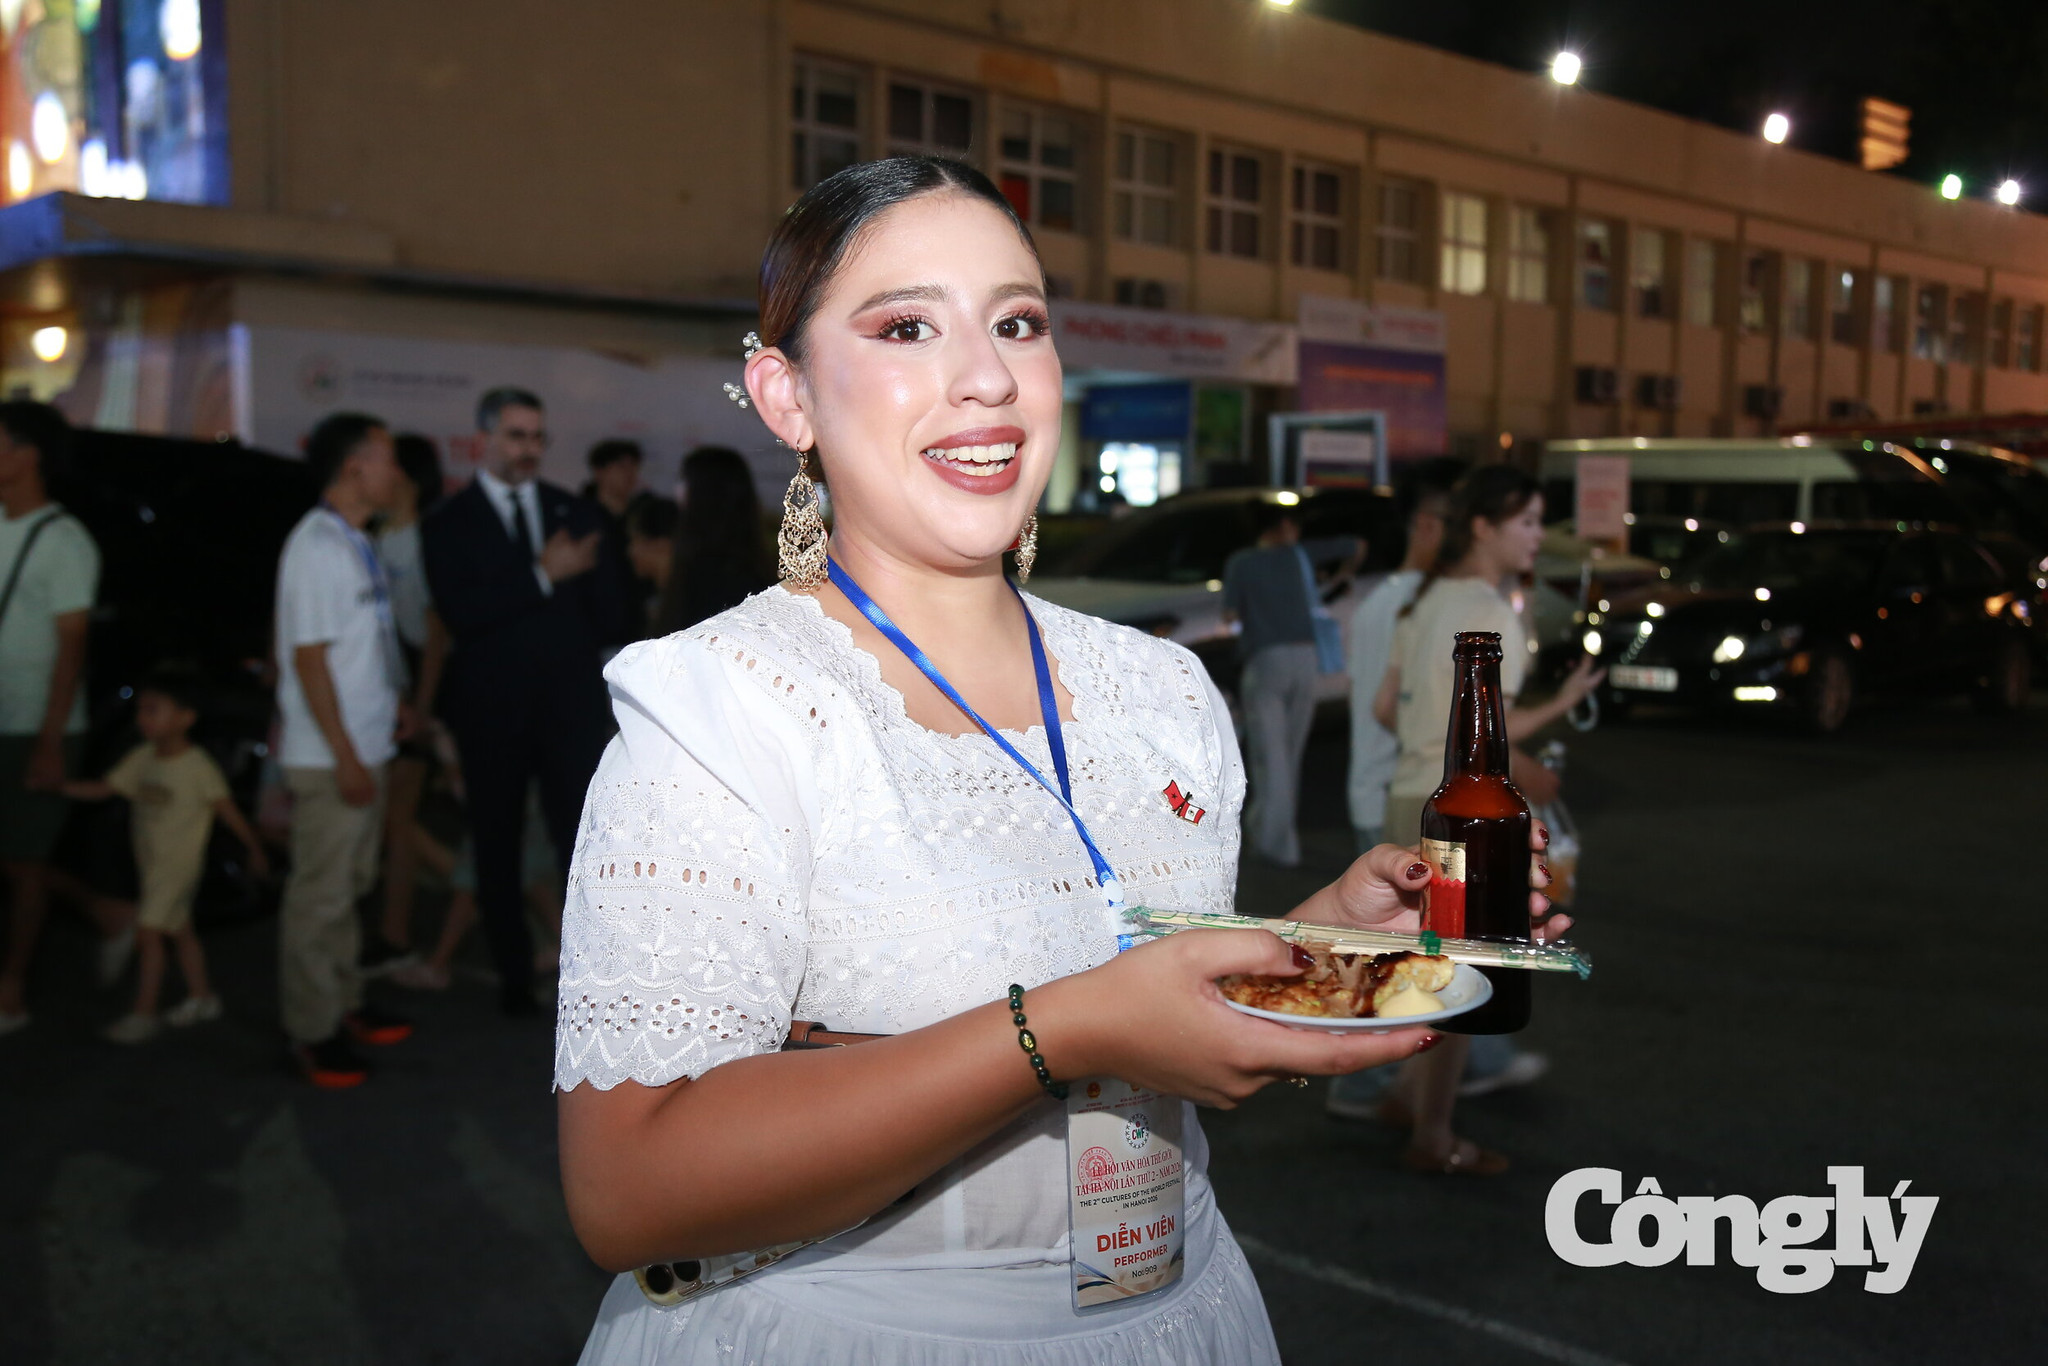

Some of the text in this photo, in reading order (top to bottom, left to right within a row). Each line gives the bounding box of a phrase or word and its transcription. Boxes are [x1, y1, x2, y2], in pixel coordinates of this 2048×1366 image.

[1131, 1127, 1145, 1140] CWF
[1104, 1161, 1119, 1175] HỘI
[1121, 1158, 1136, 1172] VĂN
[1080, 1199, 1092, 1208] THE
[1101, 1192, 1132, 1204] CULTURES
[1141, 1188, 1150, 1196] THE
[1150, 1183, 1165, 1194] WORLD
[1165, 1177, 1181, 1189] FESTIVAL
[1104, 1177, 1119, 1192] NỘI
[1130, 1198, 1148, 1208] HANOI
[1148, 1194, 1159, 1204] 2026
[1096, 1215, 1174, 1253] DIỄN VIÊN
[1114, 1244, 1168, 1268] PERFORMER
